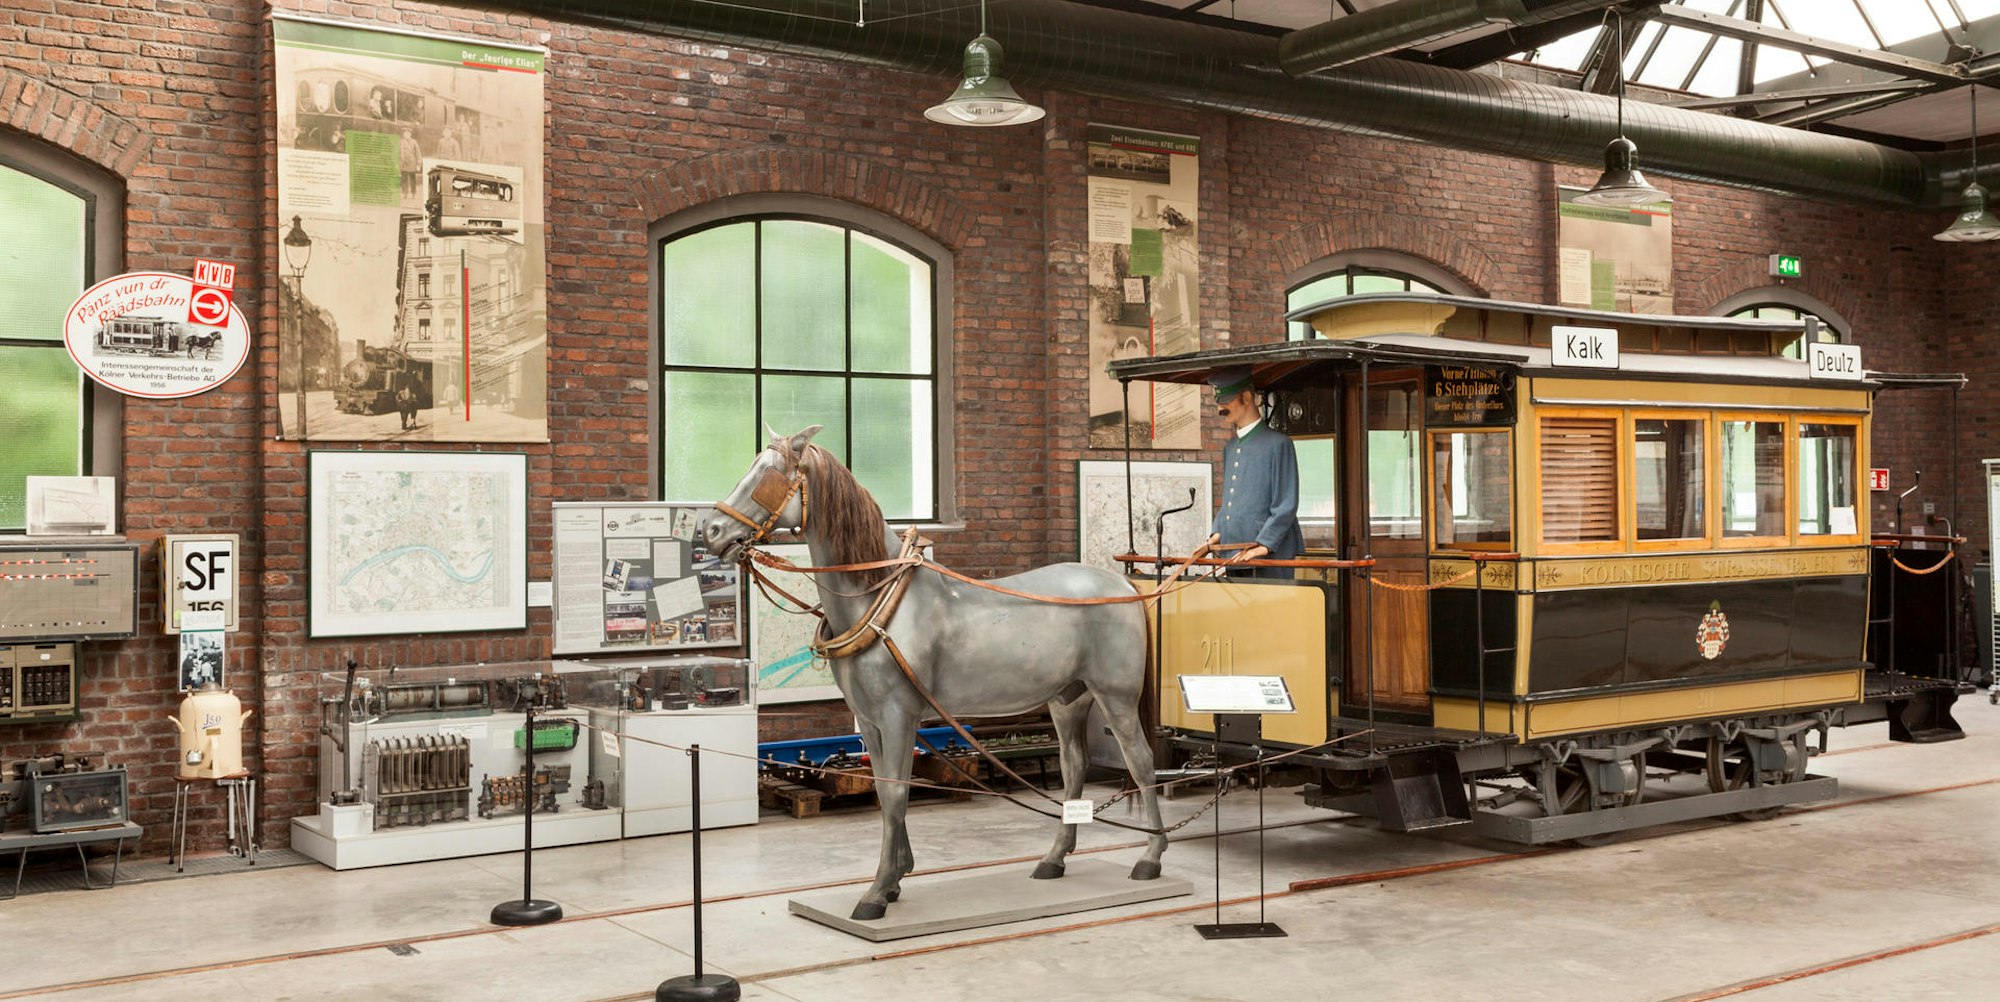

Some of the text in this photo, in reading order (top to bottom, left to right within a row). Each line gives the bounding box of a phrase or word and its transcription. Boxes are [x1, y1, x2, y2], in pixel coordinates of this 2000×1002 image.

[462, 51, 476, 60] Der
[199, 263, 231, 284] KVB
[77, 277, 170, 324] Pänz vun dr
[1567, 334, 1603, 359] Kalk
[101, 361, 199, 373] Interessengemeinschaft
[1817, 350, 1854, 373] Deutz
[129, 371, 200, 382] Verkehrs-Betriebe
[1435, 381, 1500, 399] 6 Stehplätze
[185, 551, 230, 591] SF
[1580, 555, 1837, 585] KÖLNISCHE STRASSENBAHN
